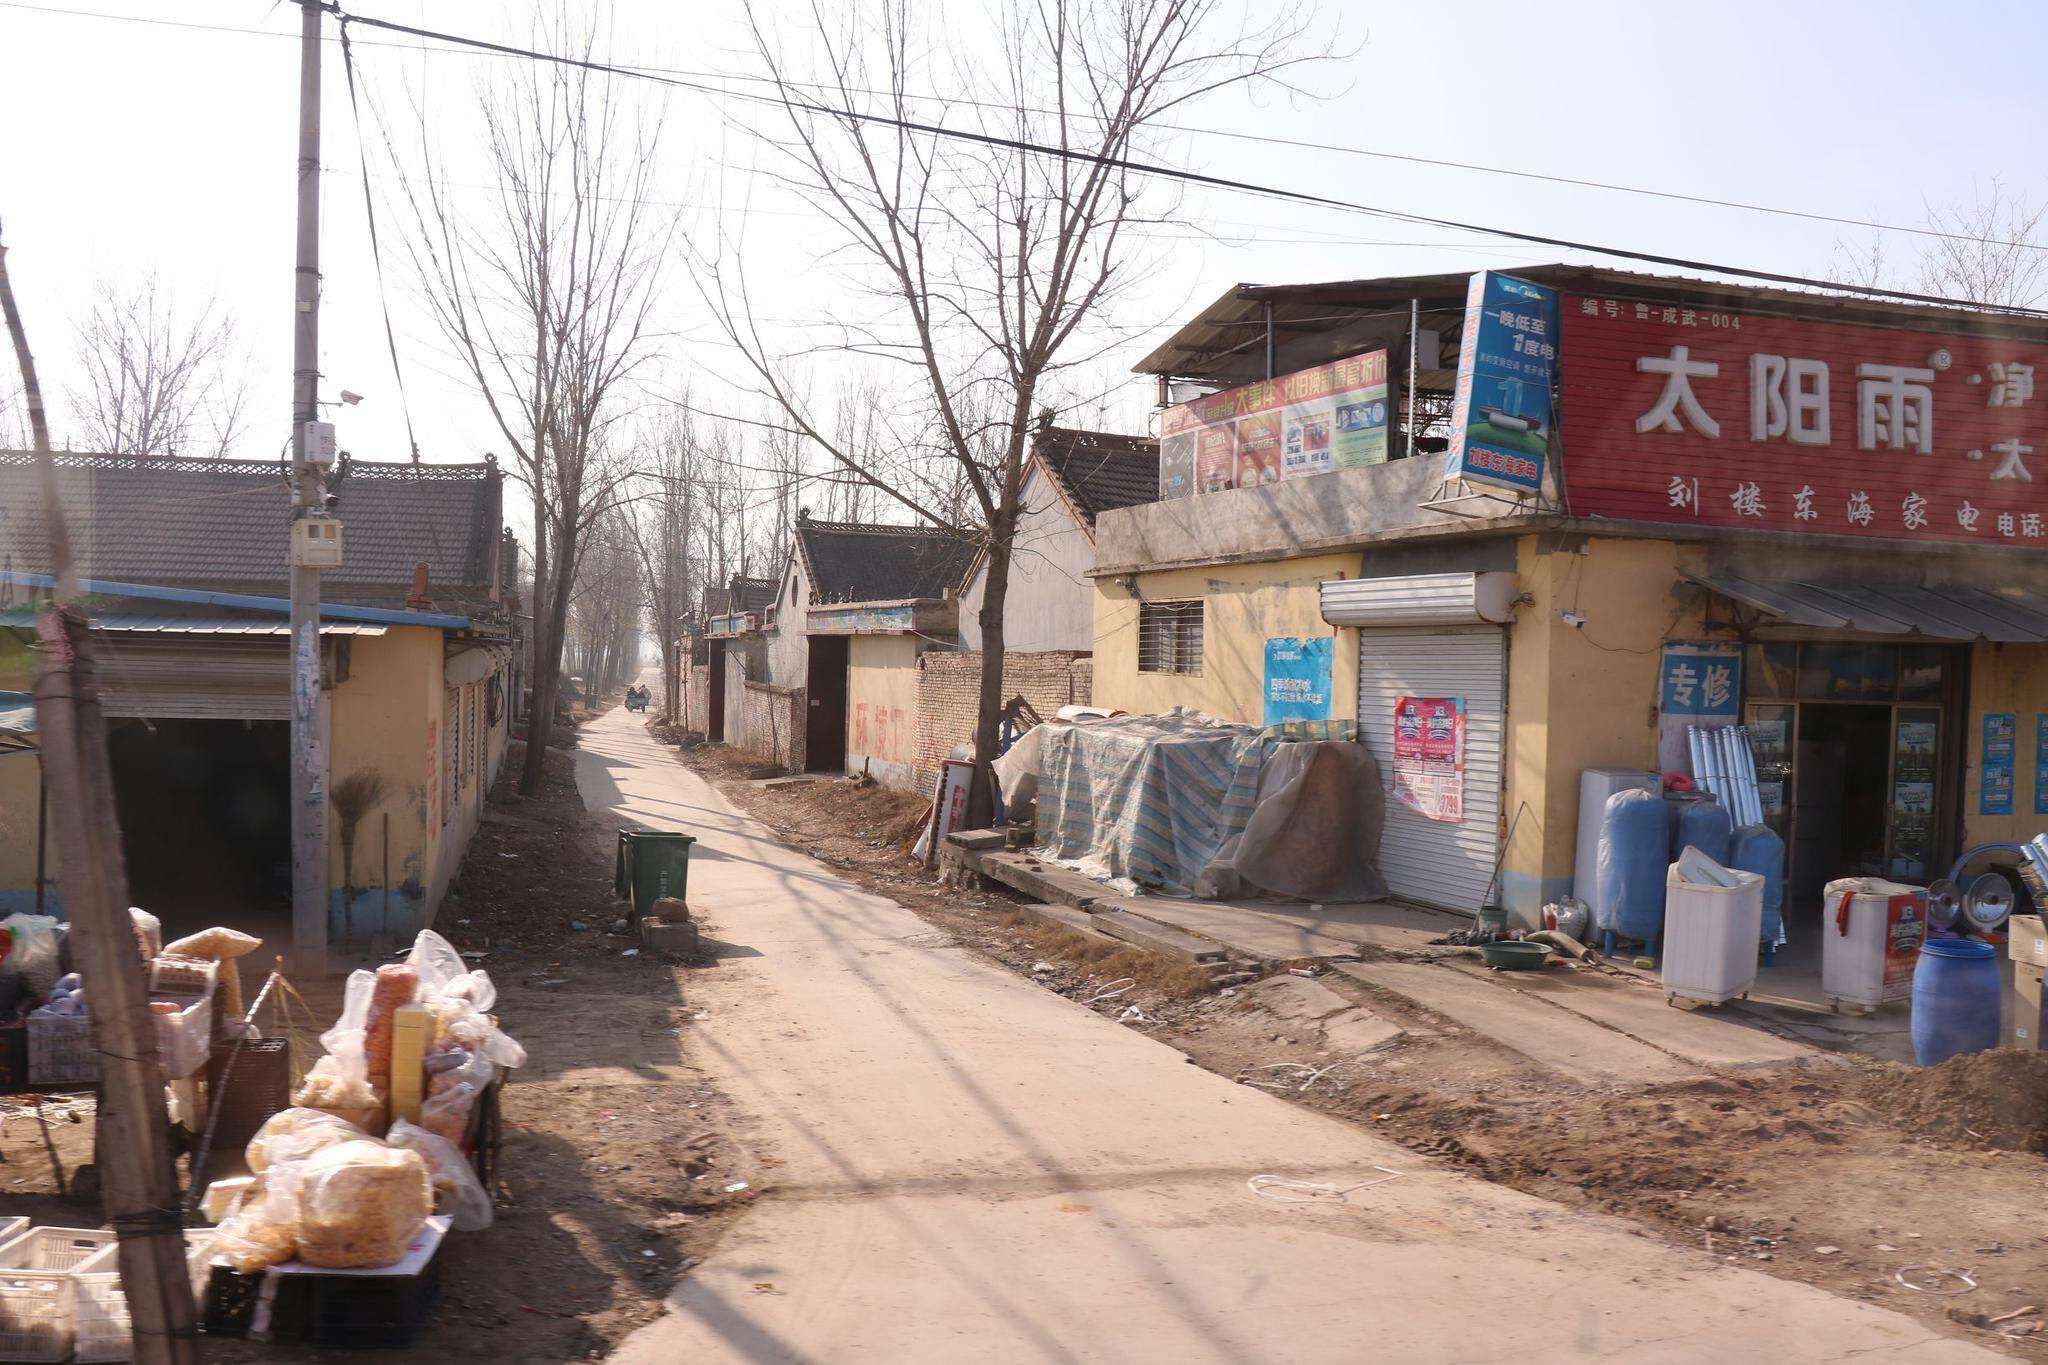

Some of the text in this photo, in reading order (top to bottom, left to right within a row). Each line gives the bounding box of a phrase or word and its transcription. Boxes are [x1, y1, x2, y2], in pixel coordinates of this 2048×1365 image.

[1485, 310, 1547, 335] 一晚低至
[1635, 344, 1936, 456] 太阳雨
[1667, 475, 1981, 533] 刘楼东海家电
[1668, 663, 1732, 708] 专修
